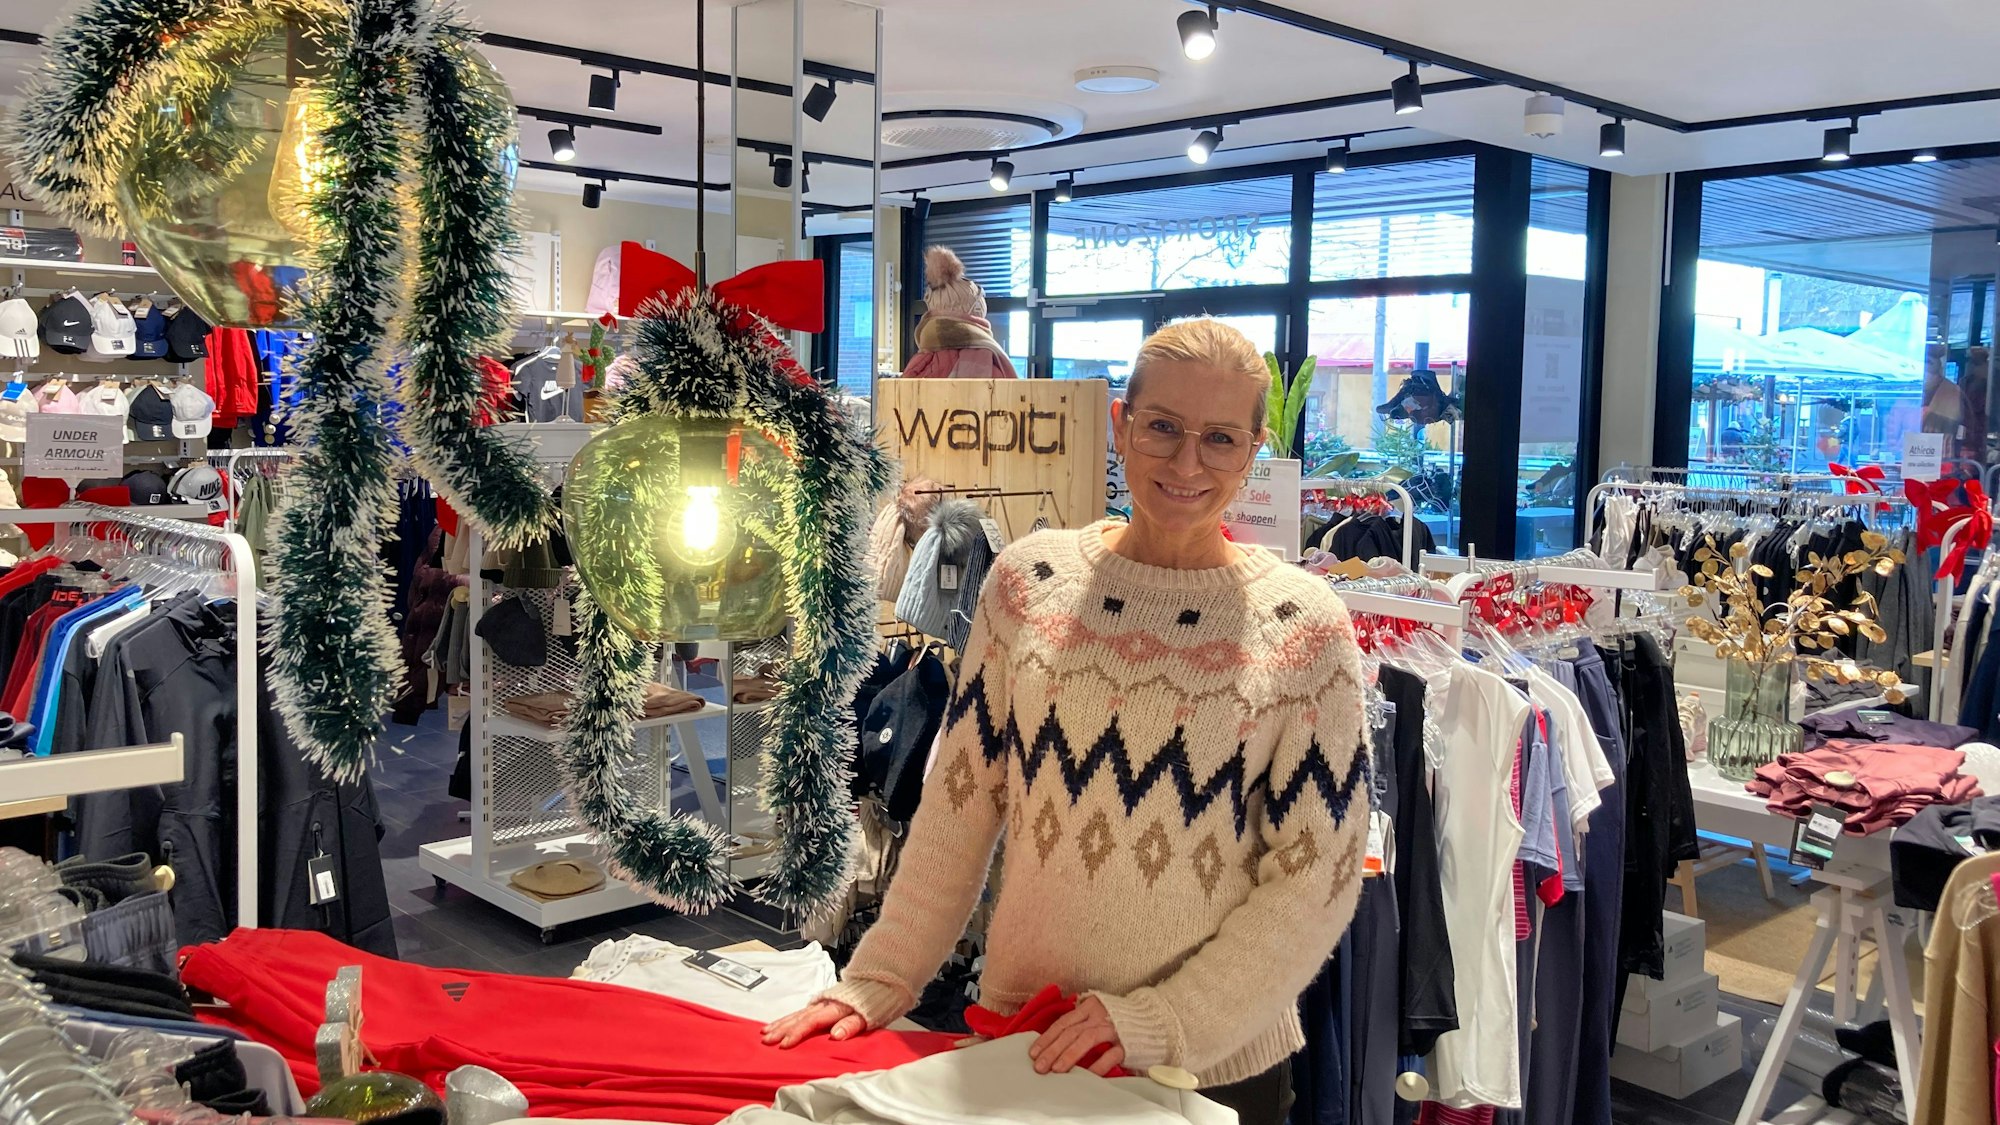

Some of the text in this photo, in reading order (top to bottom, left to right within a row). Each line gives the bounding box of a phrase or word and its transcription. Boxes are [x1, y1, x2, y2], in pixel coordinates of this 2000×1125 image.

[53, 430, 98, 441] UNDER
[893, 395, 1067, 467] wapiti
[44, 448, 105, 459] ARMOUR
[1250, 489, 1272, 503] Sale
[1236, 511, 1277, 525] shoppen!
